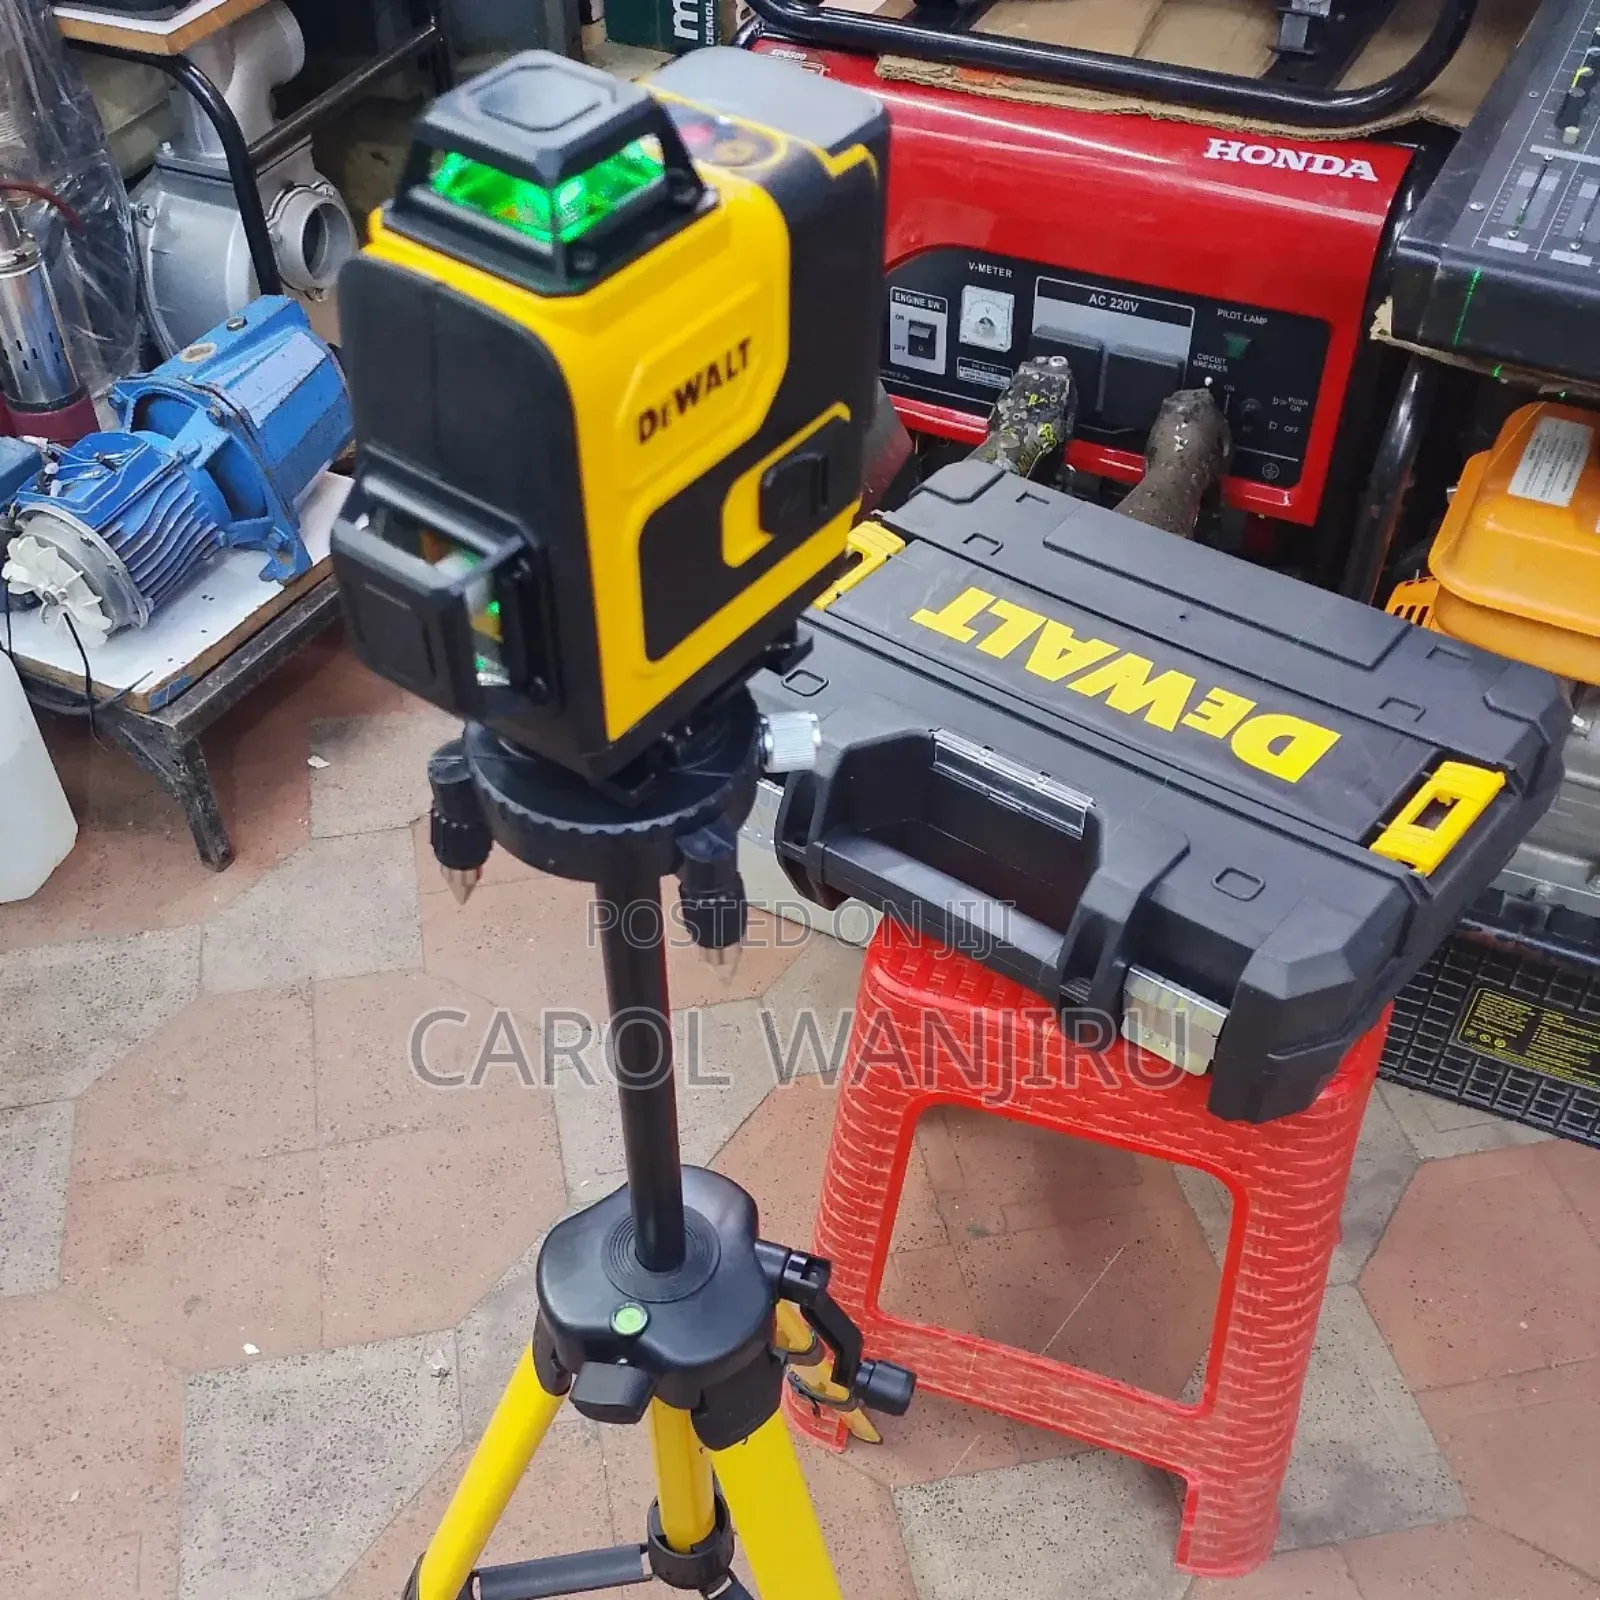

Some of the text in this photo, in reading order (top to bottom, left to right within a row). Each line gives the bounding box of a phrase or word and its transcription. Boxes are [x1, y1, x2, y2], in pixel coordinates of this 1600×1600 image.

[1203, 137, 1379, 183] HONDA
[895, 292, 925, 307] ENGINE
[1088, 294, 1139, 312] AC 220V
[1217, 308, 1268, 325] PILOT LAMP
[1193, 359, 1228, 373] BREAKER
[1196, 353, 1226, 364] CIRCUIT
[910, 586, 1342, 783] DEWALT
